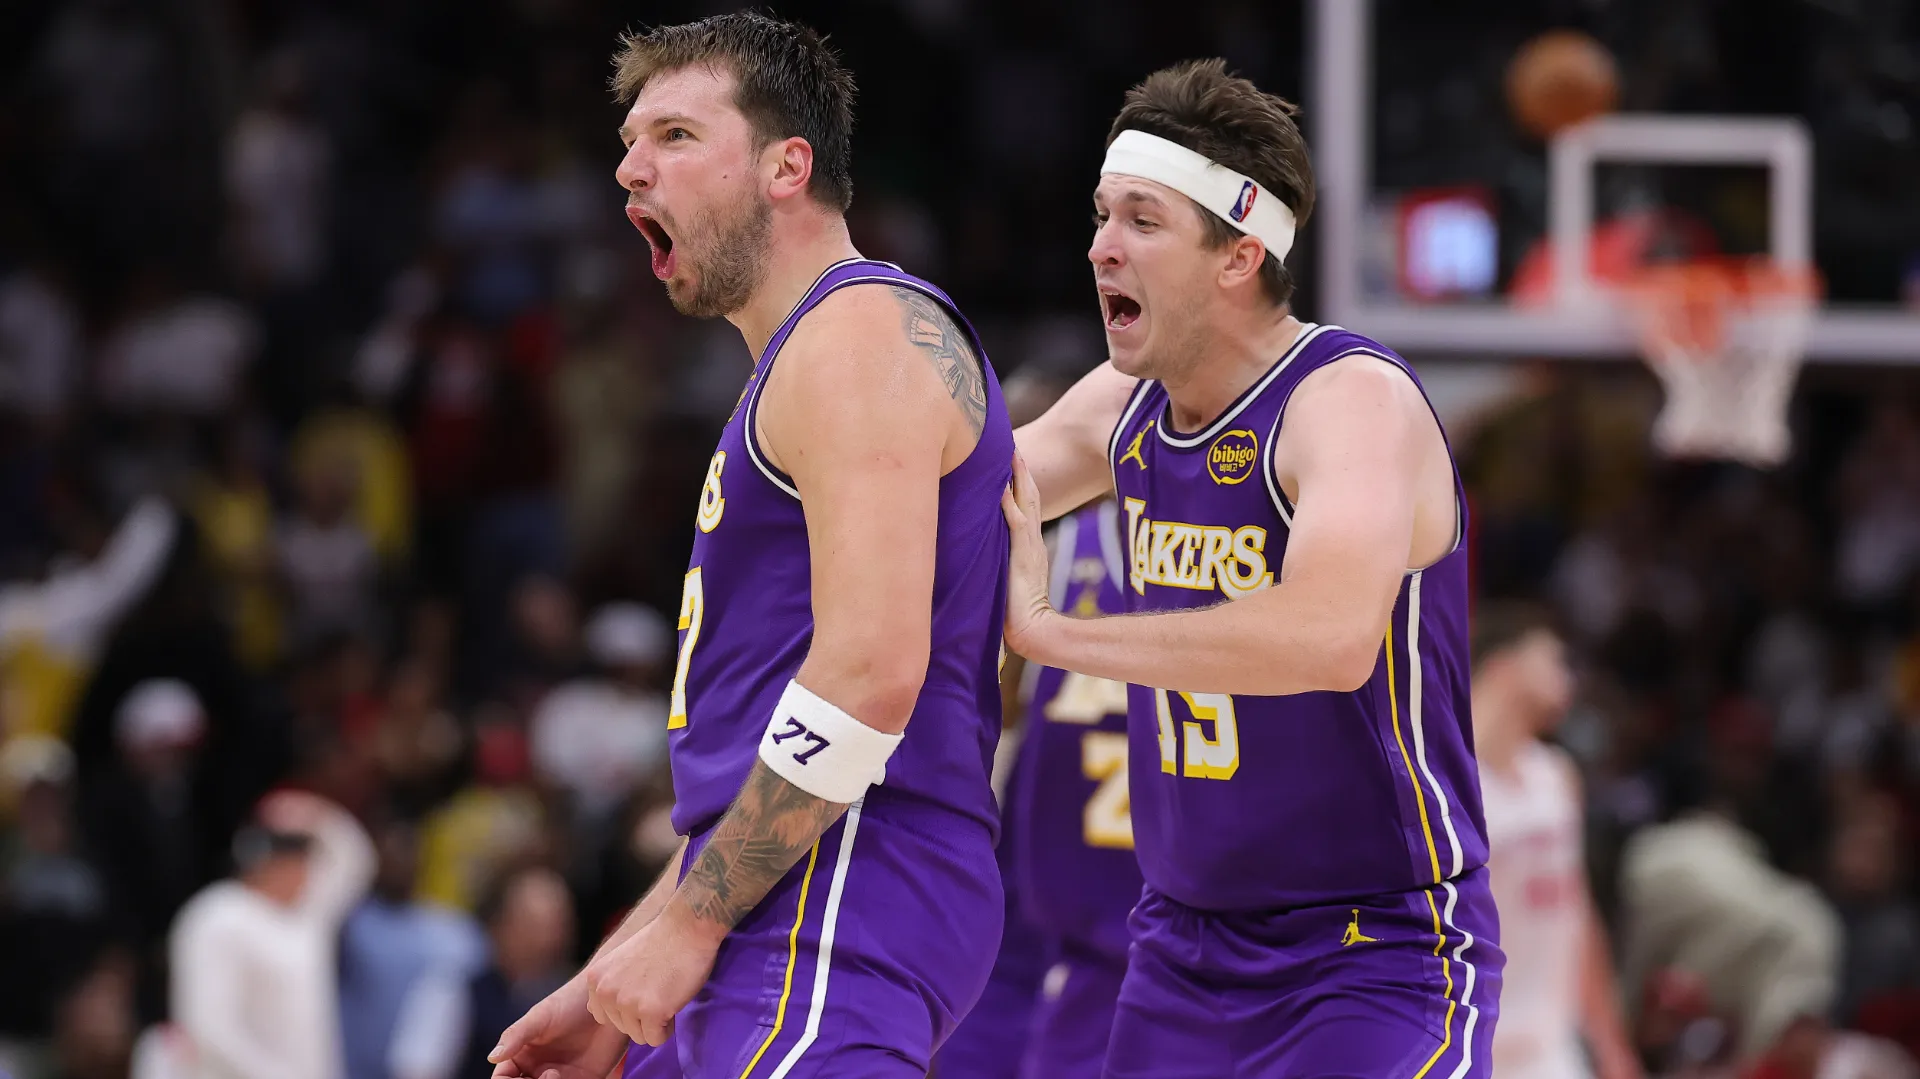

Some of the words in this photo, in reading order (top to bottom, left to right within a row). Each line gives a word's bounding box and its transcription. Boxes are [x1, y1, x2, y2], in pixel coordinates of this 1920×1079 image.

[1212, 443, 1255, 468] bibigo
[1123, 496, 1275, 600] LAKERS
[772, 716, 831, 766] 77
